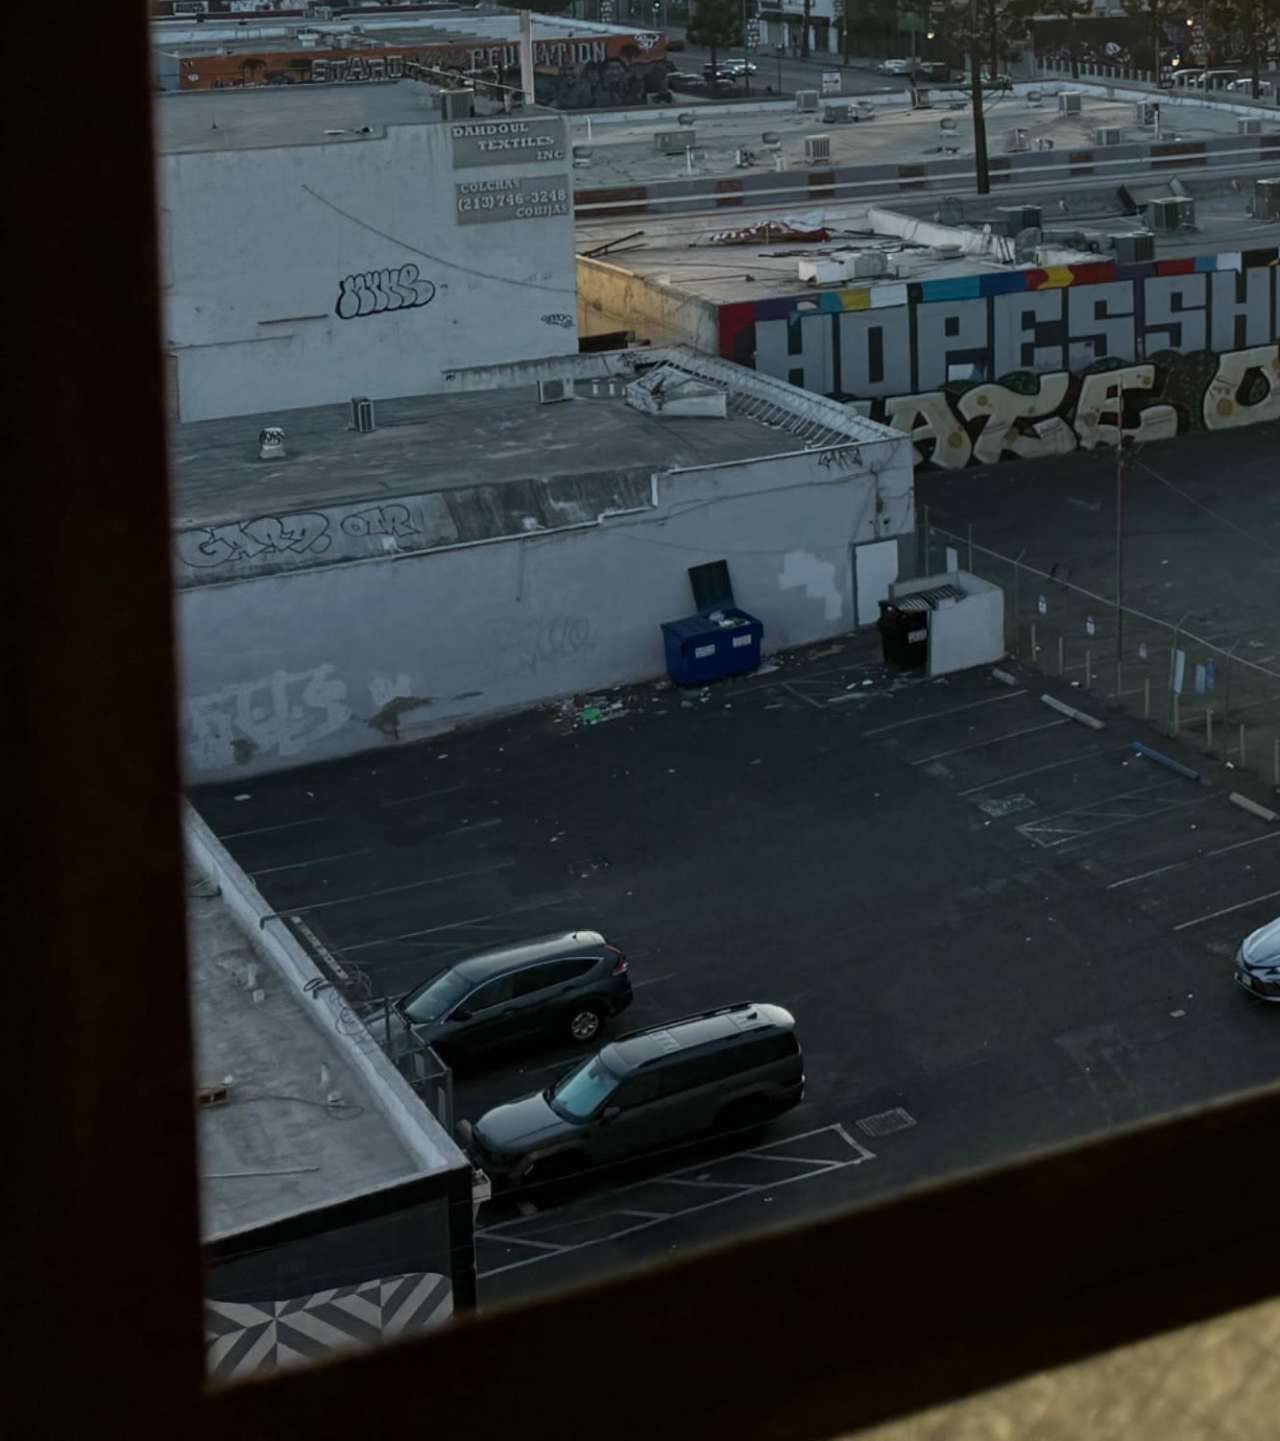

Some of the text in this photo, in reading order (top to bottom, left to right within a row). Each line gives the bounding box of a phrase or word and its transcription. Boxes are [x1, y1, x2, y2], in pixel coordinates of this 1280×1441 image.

[453, 123, 529, 138] DAHDOUL
[478, 136, 555, 151] TEXTILES
[537, 150, 565, 161] INC
[460, 177, 521, 194] COLCHAS
